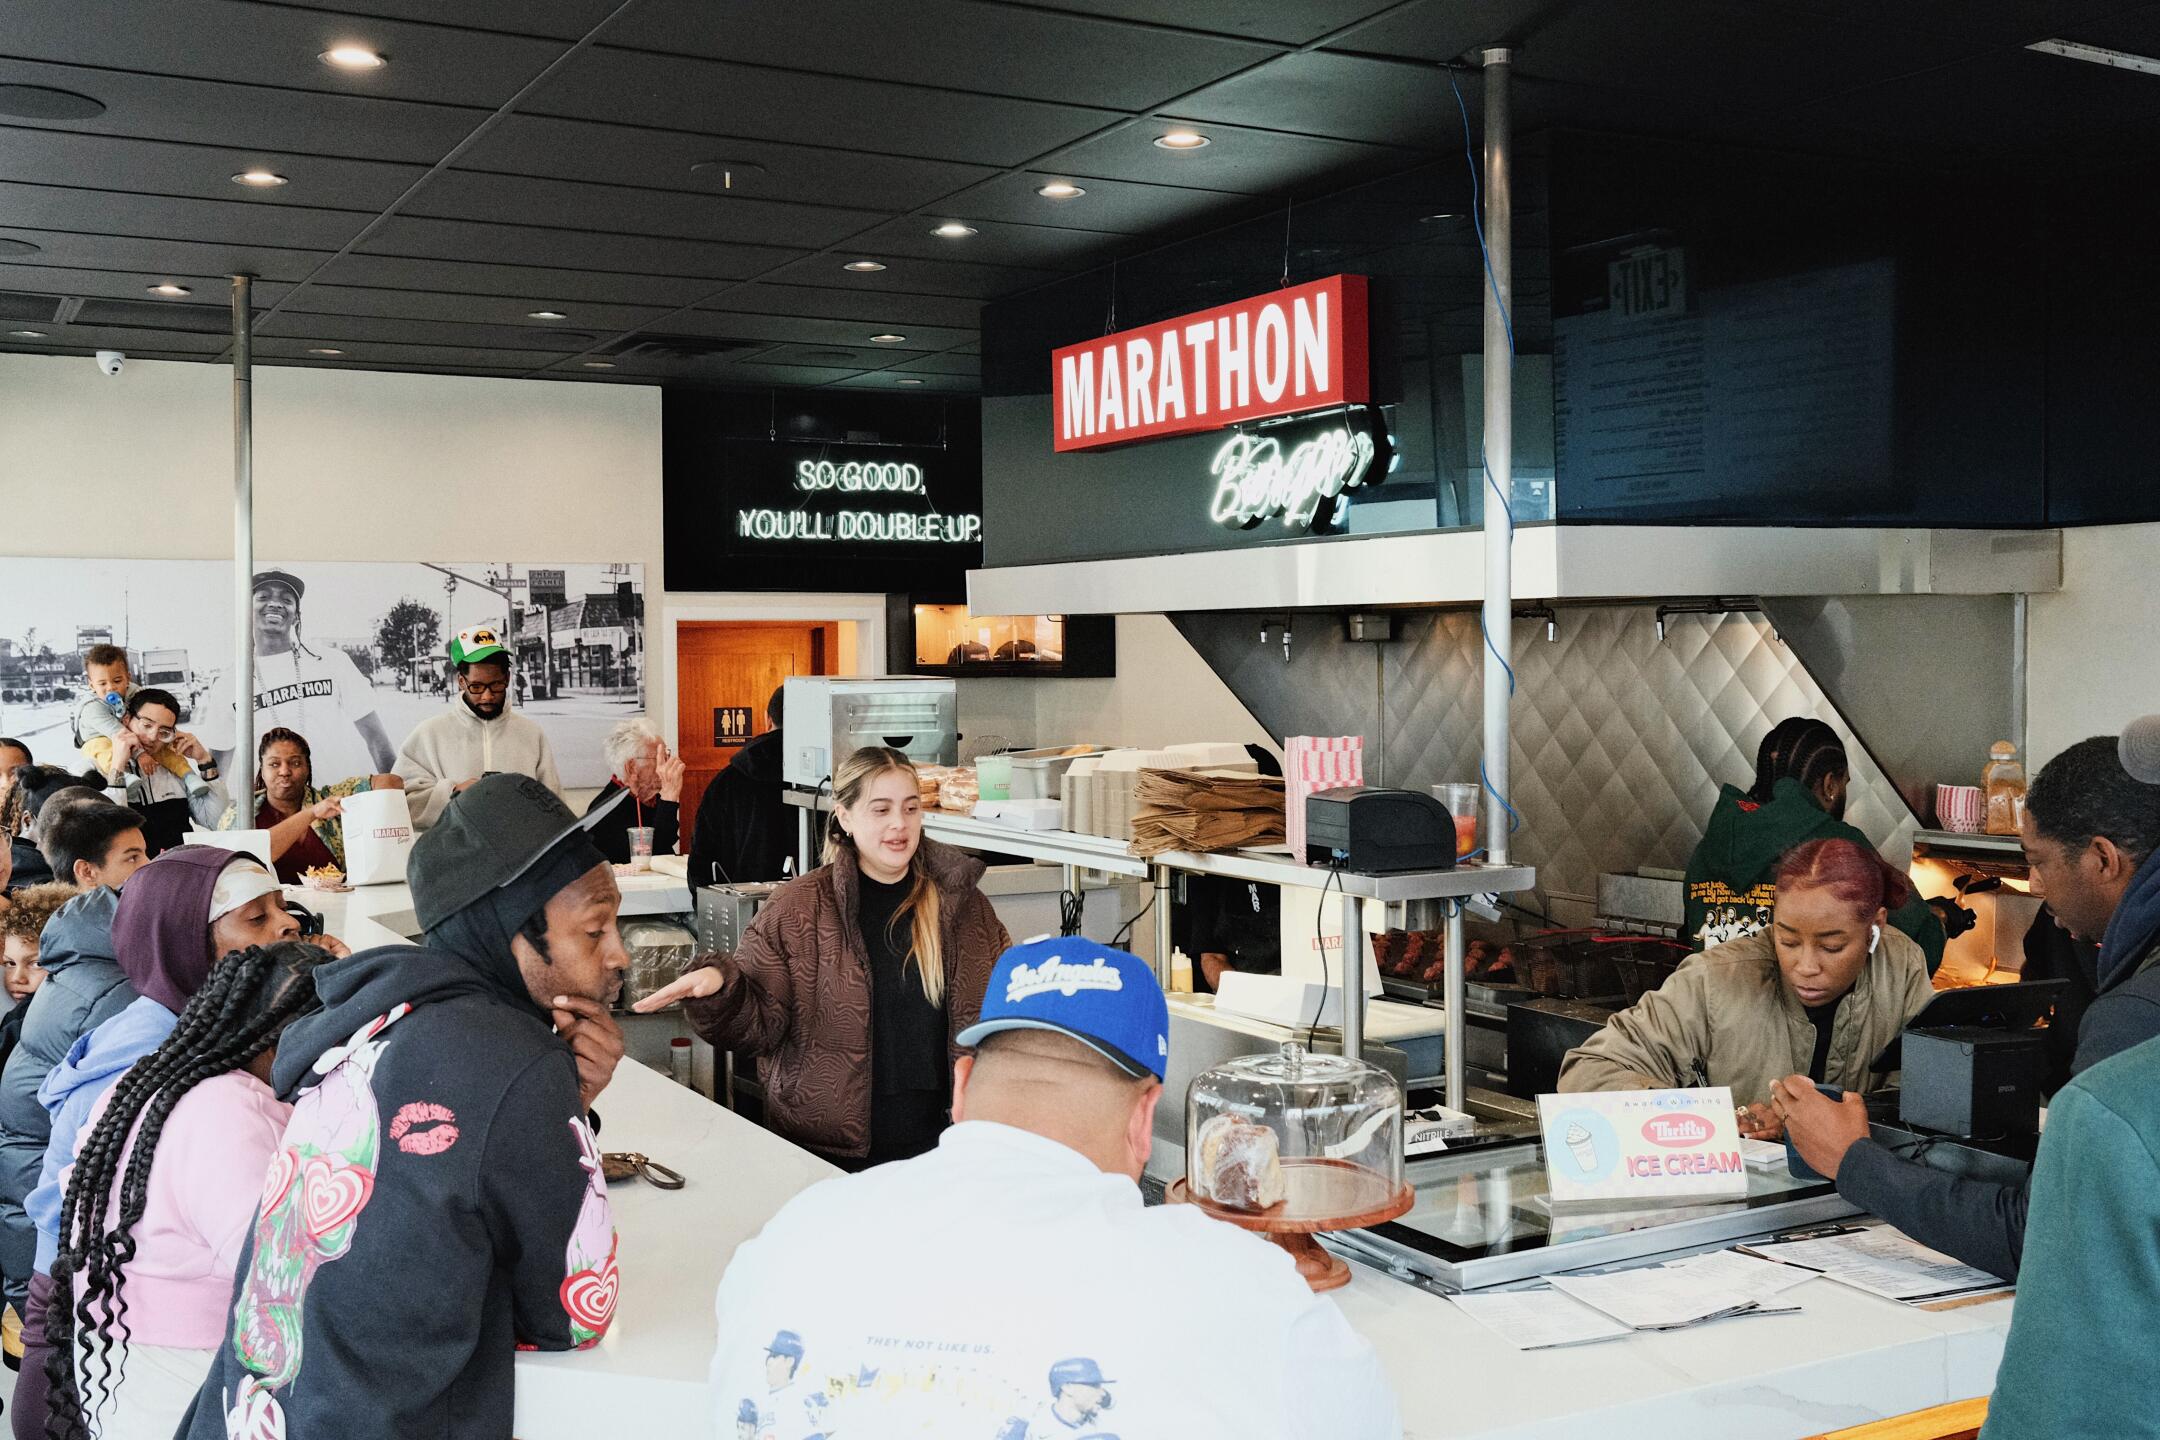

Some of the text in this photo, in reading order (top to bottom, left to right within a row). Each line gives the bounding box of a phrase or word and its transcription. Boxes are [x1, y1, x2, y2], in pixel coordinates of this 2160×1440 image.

[1062, 292, 1329, 440] MARATHON
[799, 460, 926, 495] SO GOOD,
[839, 510, 941, 541] DOUBLE
[261, 680, 332, 707] MARATHON
[1415, 1129, 1451, 1142] NITRILE
[1650, 1120, 1706, 1140] Thrifty
[1626, 1151, 1743, 1177] ICE CREAM
[866, 1336, 900, 1347] THEY
[904, 1340, 934, 1350] NOT
[938, 1343, 969, 1353] LIKE
